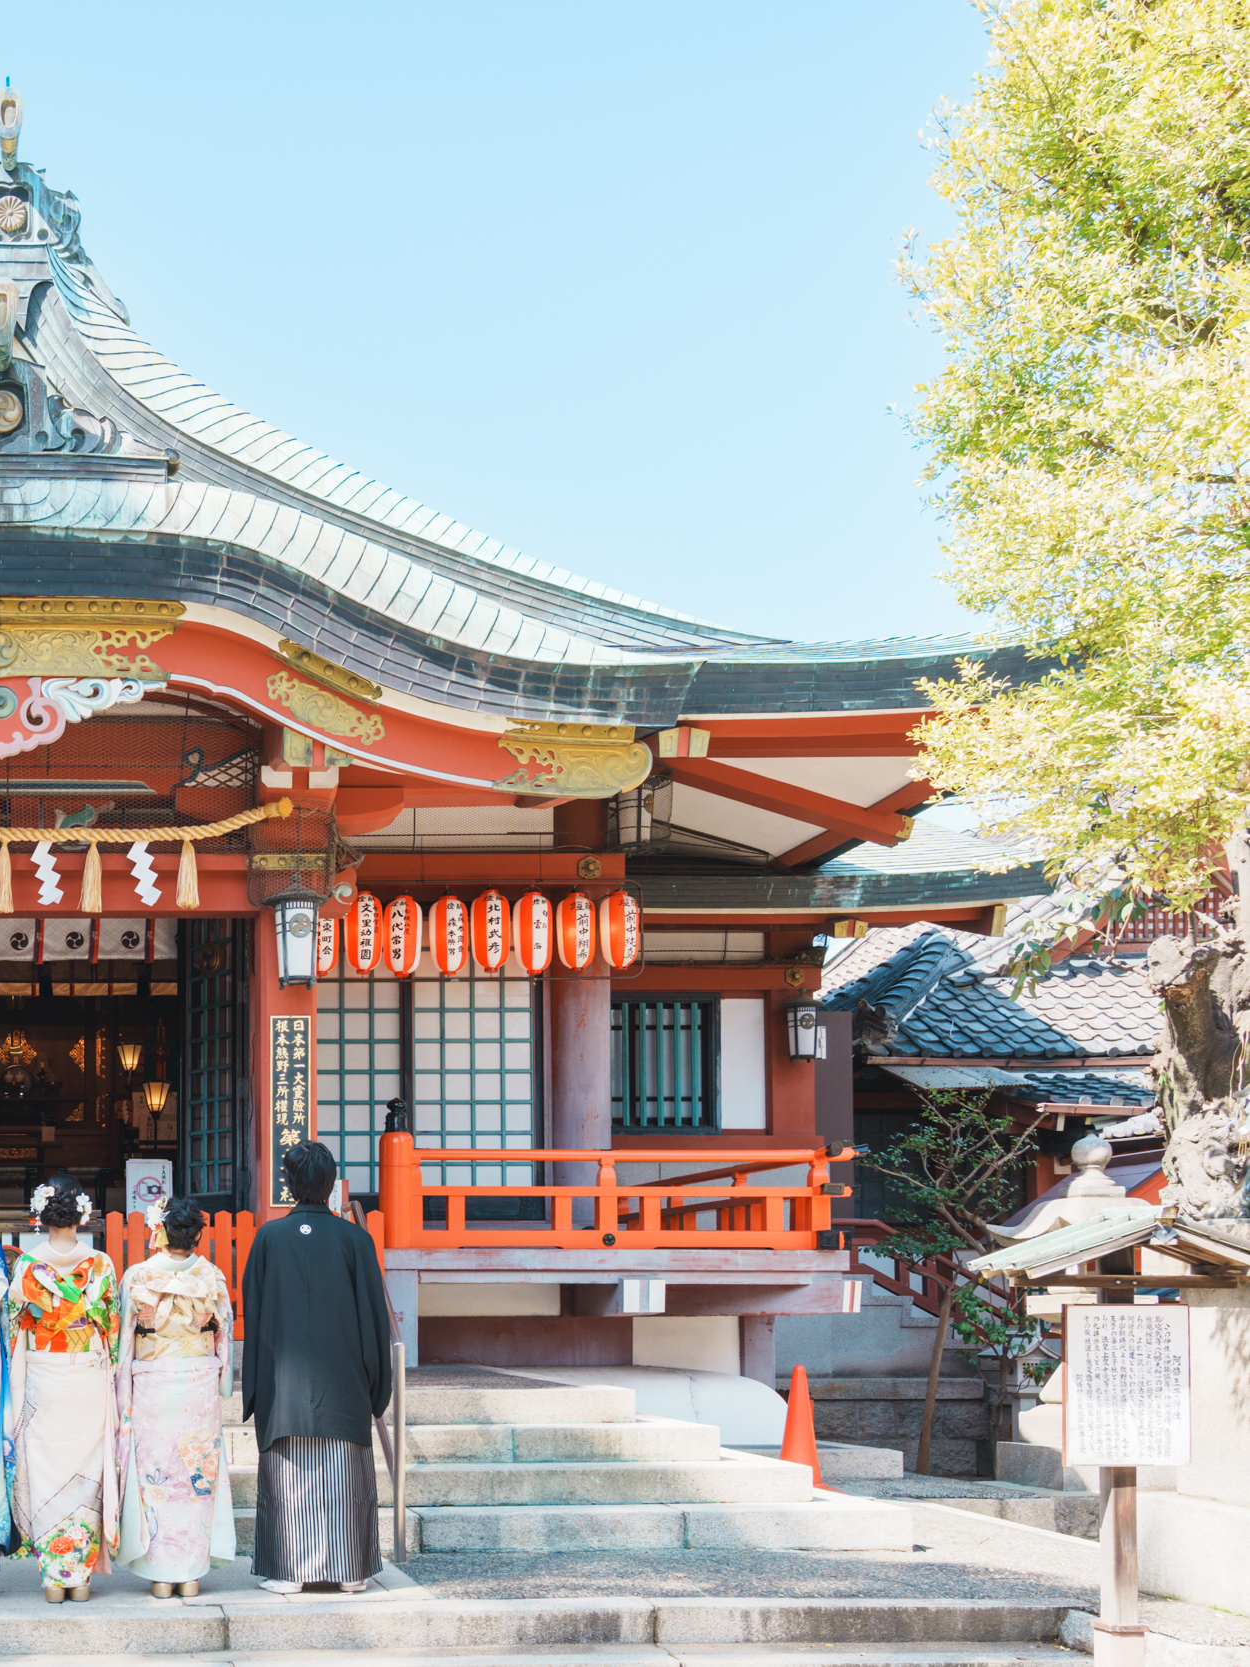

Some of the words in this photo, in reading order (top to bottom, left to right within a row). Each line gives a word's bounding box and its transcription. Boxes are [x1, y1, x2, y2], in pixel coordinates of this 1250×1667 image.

[360, 903, 372, 961] 文の里幼稚園
